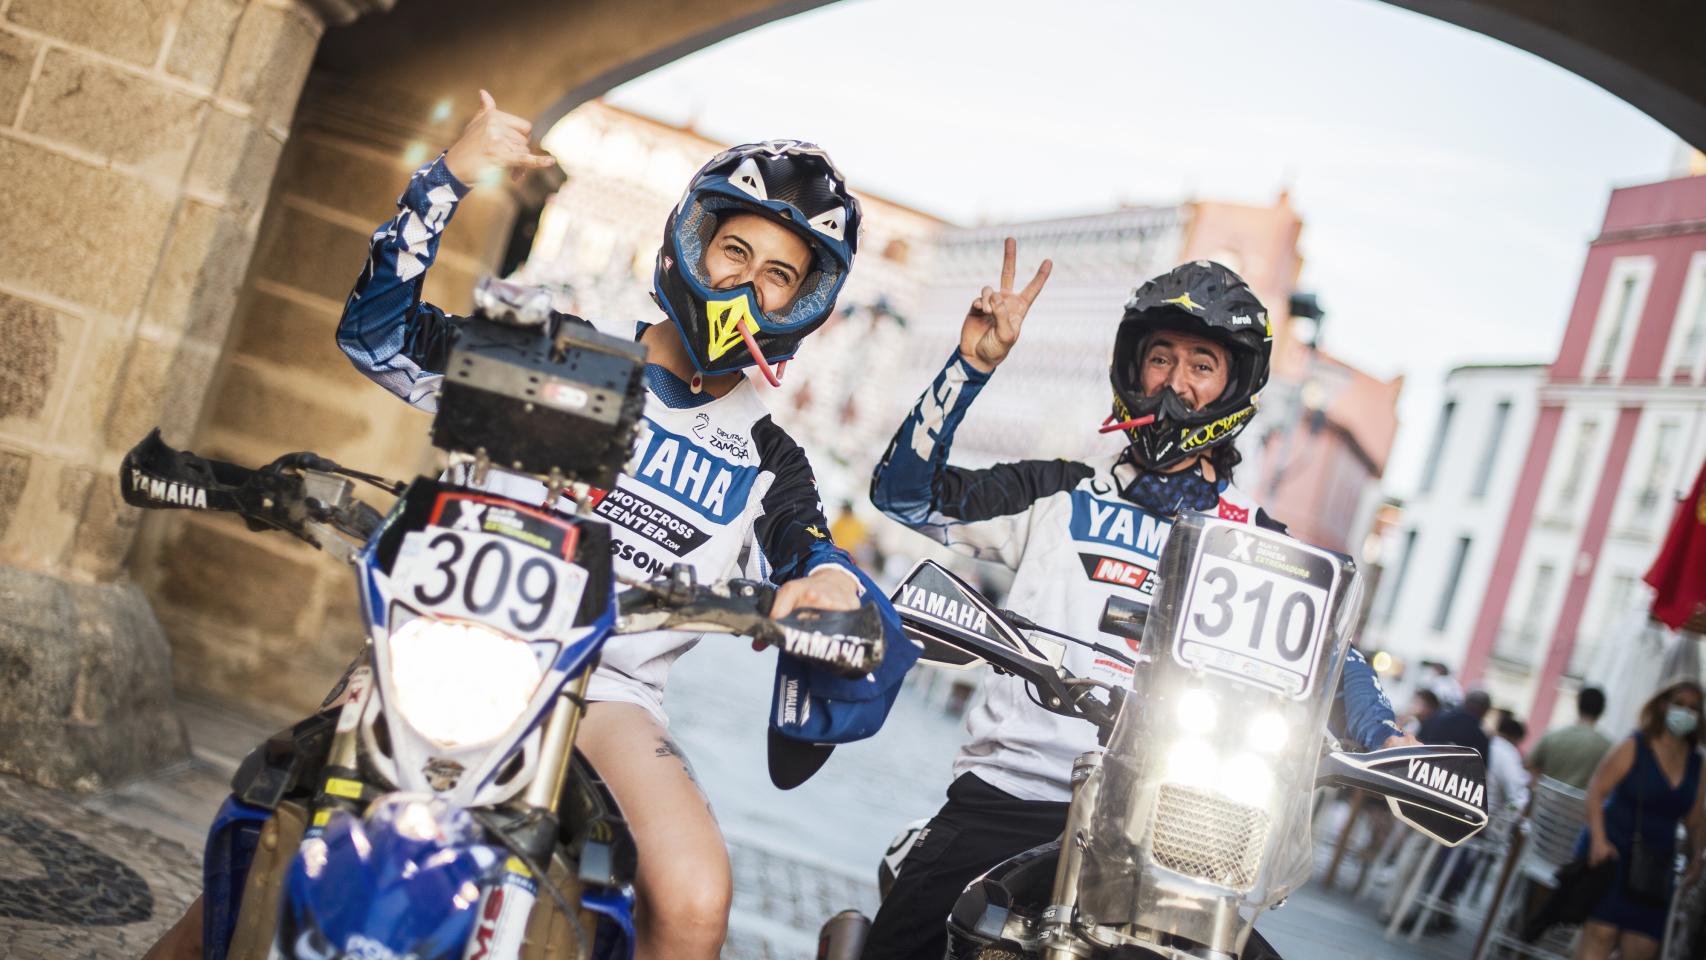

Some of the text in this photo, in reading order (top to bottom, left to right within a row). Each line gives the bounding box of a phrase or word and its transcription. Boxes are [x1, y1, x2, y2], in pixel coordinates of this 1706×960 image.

[130, 469, 208, 509] YAMAHA
[607, 489, 695, 539] MOTOCROSS
[1088, 497, 1172, 557] YAM
[413, 532, 558, 633] 309
[901, 584, 988, 634] YAMAHA
[1193, 566, 1316, 662] 310
[783, 627, 866, 669] YAMAHA
[783, 679, 799, 724] YAMALUBE
[1406, 757, 1485, 807] YAMAHA
